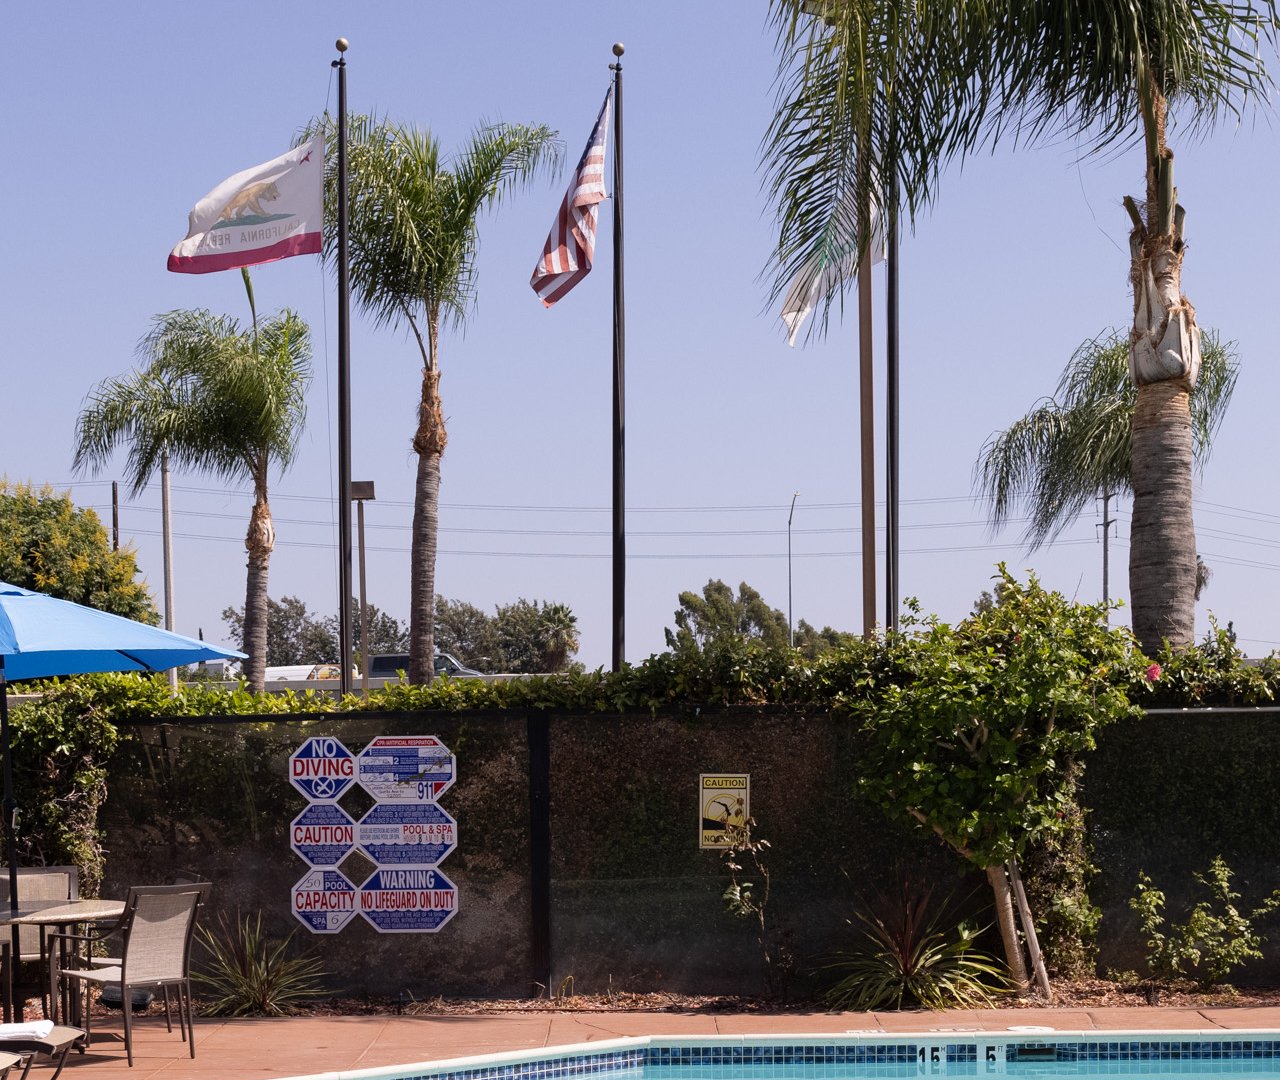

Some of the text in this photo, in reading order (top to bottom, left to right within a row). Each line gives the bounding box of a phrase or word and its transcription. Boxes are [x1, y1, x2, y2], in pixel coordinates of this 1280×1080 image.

[312, 739, 337, 758] NO
[293, 758, 354, 777] DIVING
[393, 757, 399, 765] 2
[417, 782, 433, 799] 911
[294, 826, 353, 843] CAUTION
[403, 825, 453, 834] POOL & SPA
[305, 879, 321, 889] 50
[325, 882, 348, 890] POOL
[380, 871, 435, 889] WARNING
[296, 891, 356, 909] CAPACITY
[361, 891, 455, 909] NO LIFEGUARD ON DUTY
[312, 917, 326, 925] SPA
[331, 915, 340, 924] 6
[986, 1045, 996, 1061] 5
